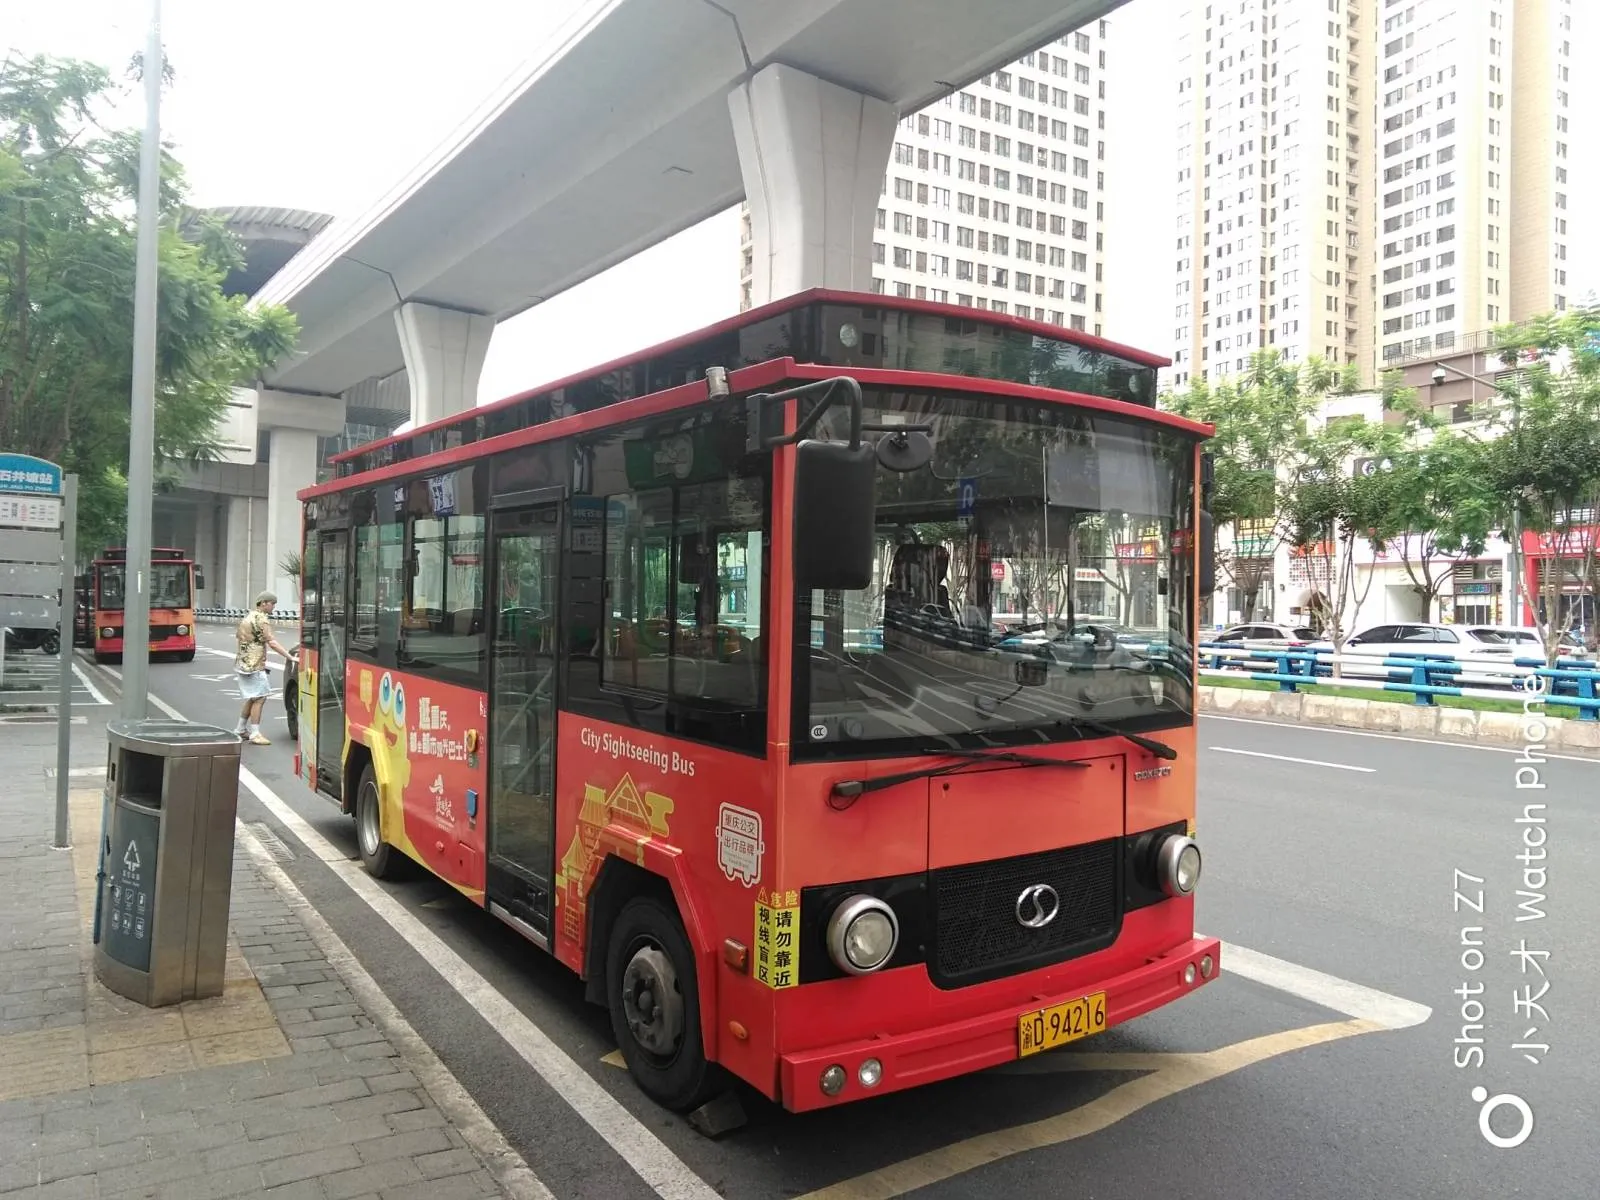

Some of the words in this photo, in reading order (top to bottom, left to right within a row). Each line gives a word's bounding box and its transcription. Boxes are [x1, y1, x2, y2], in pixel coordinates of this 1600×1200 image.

[581, 727, 601, 754] City
[602, 732, 669, 775] Sightseeing
[672, 751, 696, 777] Bus
[725, 813, 756, 836] 重庆公交
[723, 835, 755, 857] 出行品牌
[770, 890, 799, 907] 危险
[758, 907, 770, 984] 视线盲区
[774, 911, 793, 988] 请勿靠近
